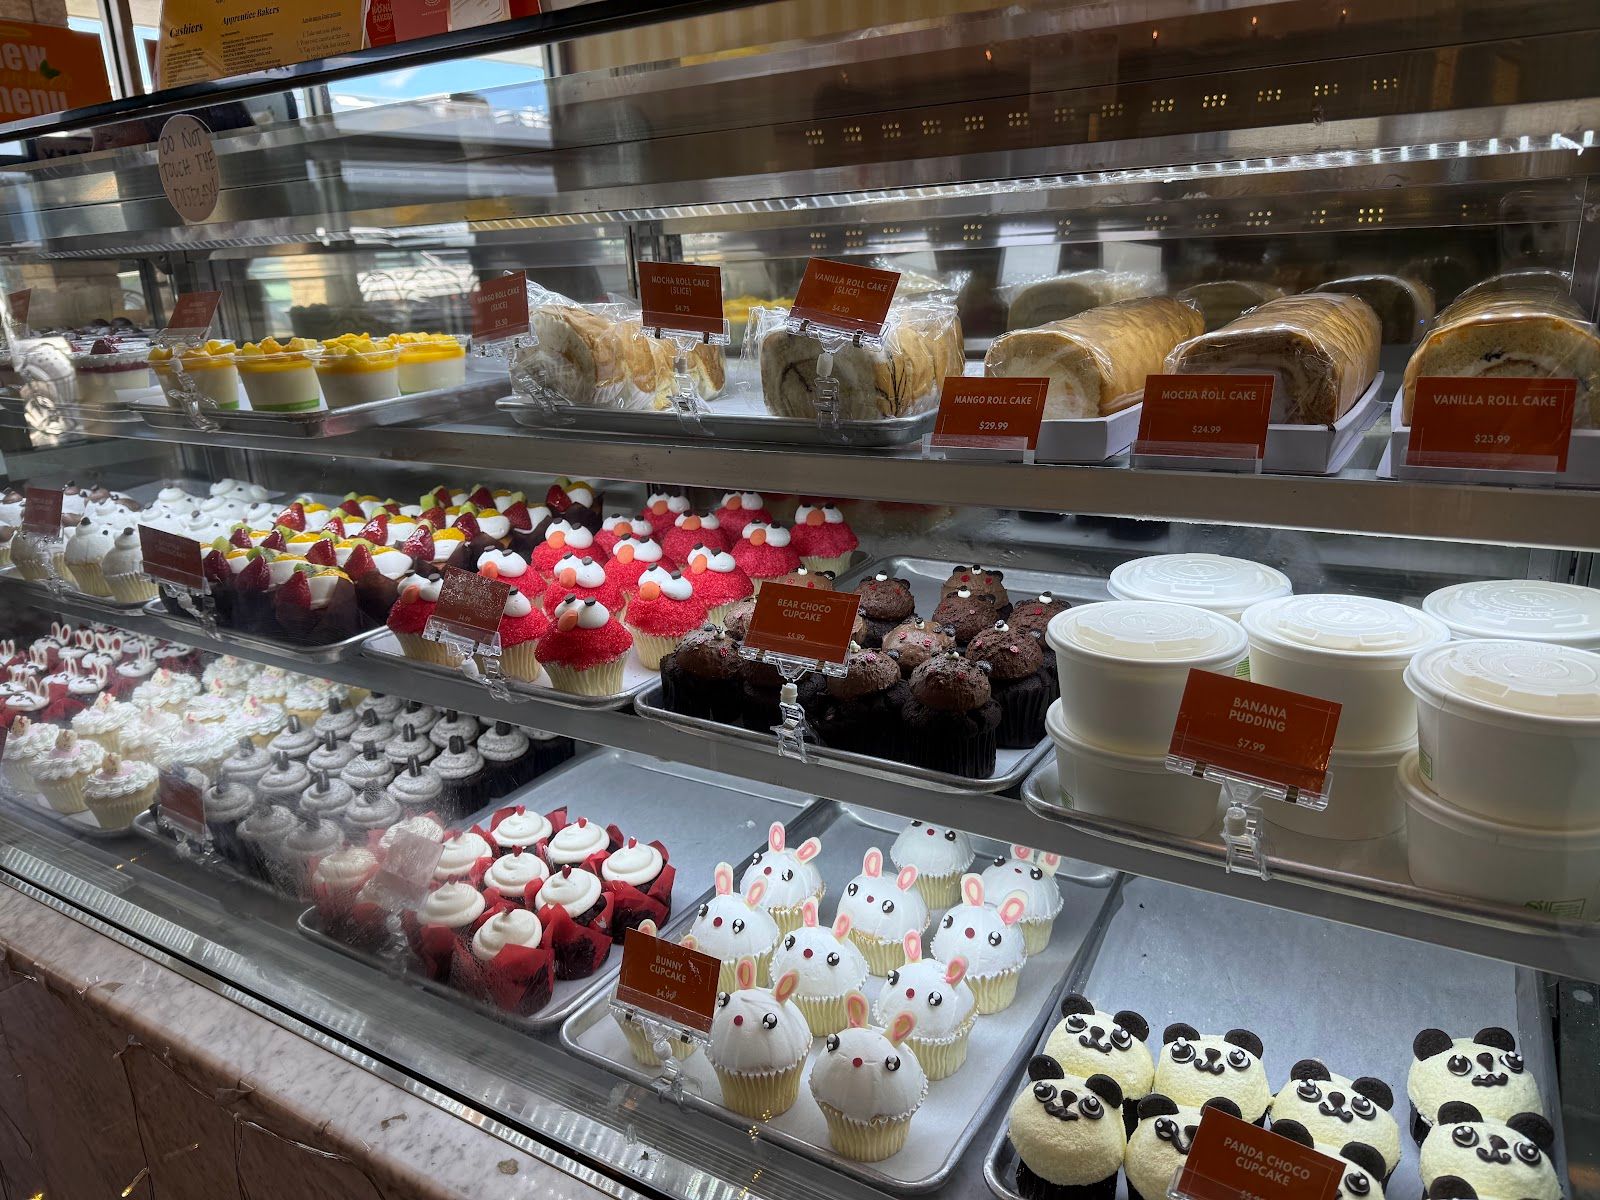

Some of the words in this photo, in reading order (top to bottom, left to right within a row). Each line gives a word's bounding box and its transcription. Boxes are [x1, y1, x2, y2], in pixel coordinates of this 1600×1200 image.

[223, 10, 256, 26] Apprentice
[256, 6, 280, 18] Bakers
[169, 22, 204, 38] Cashiers
[0, 43, 47, 72] ew
[160, 135, 175, 155] DO
[181, 127, 202, 149] NOT
[161, 159, 192, 182] TOUCH
[195, 150, 215, 172] THE
[651, 275, 675, 285] MOCHA
[675, 278, 692, 287] ROLL
[692, 279, 710, 288] CAKE
[814, 272, 845, 285] VANILLA
[846, 278, 865, 289] ROLL
[866, 282, 888, 292] CAKE
[476, 292, 495, 304] MANGO
[495, 289, 507, 300] ROLL
[507, 286, 520, 297] CAKE
[670, 286, 692, 297] (SLICE)
[833, 286, 860, 298] (SLICE)
[954, 395, 986, 405] MANGO
[986, 396, 1008, 405] ROLL
[1009, 396, 1033, 406] CAKE
[1161, 390, 1199, 400] MOCHA
[1201, 390, 1228, 400] ROLL
[1229, 391, 1257, 401] CAKE
[1433, 394, 1484, 406] VANILLA
[1487, 395, 1519, 407] ROLL
[1522, 395, 1557, 407] CAKE
[978, 421, 1009, 432] $29.99
[1191, 424, 1222, 435] $24.99
[1473, 433, 1511, 445] $23.99
[777, 598, 799, 609] BEAR
[800, 601, 832, 614] CHOCO
[782, 608, 822, 622] CUPCAKE
[1232, 697, 1288, 720] BANANA
[1228, 709, 1287, 732] PUDDING
[1236, 737, 1266, 753] $7.99
[655, 954, 684, 972] BUNNY
[649, 963, 687, 984] CUPCAKE
[1223, 1137, 1264, 1160] PANDA
[1266, 1154, 1311, 1180] CHOCO
[1235, 1156, 1291, 1187] CUPCAKE
